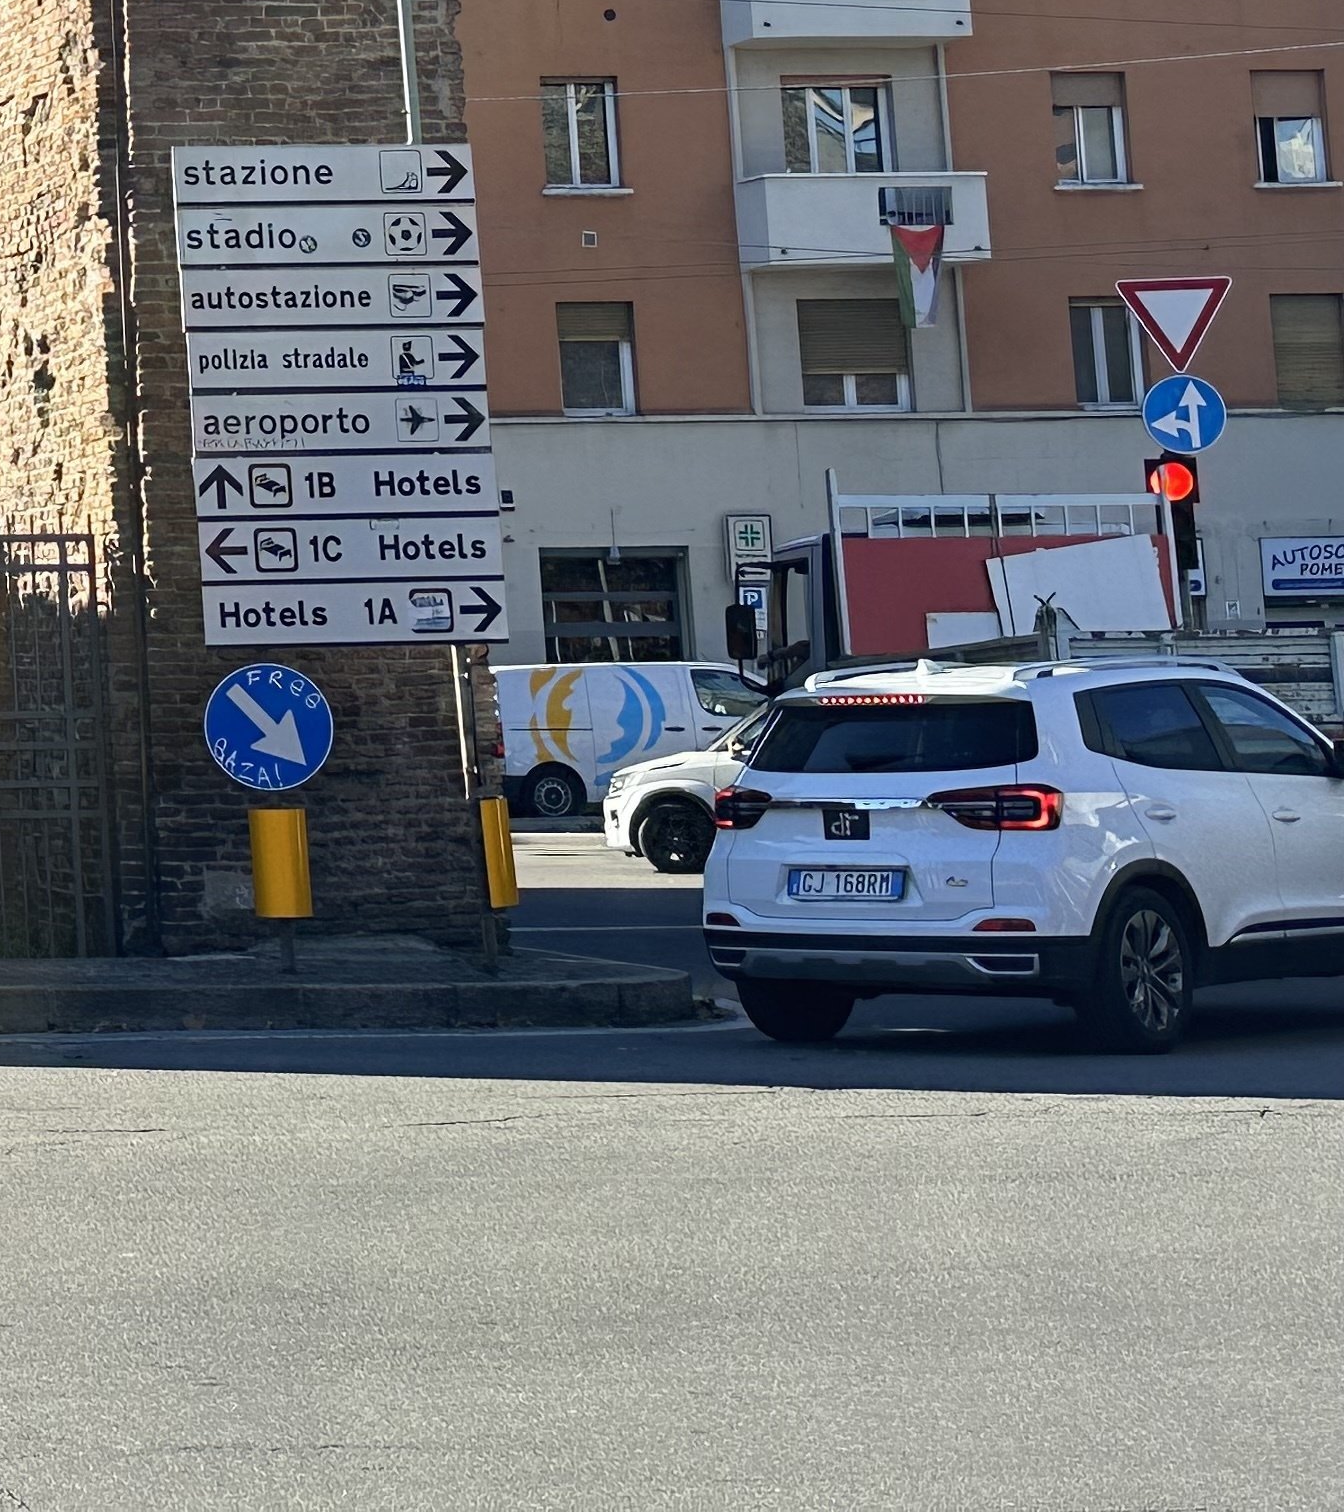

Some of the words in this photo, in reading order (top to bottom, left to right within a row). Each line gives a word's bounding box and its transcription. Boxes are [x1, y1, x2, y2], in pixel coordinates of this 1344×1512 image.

[183, 158, 334, 187] stazione
[186, 222, 297, 251] stadio
[190, 284, 372, 310] autostazione
[198, 347, 269, 374] polizia
[281, 346, 369, 370] stradale
[202, 407, 371, 440] aeroporto
[304, 471, 337, 499] 1B
[373, 469, 482, 497] Hotels
[308, 534, 344, 563] 1C
[378, 533, 487, 561] Hotels
[218, 599, 329, 628] Hotels
[363, 597, 399, 625] 1A
